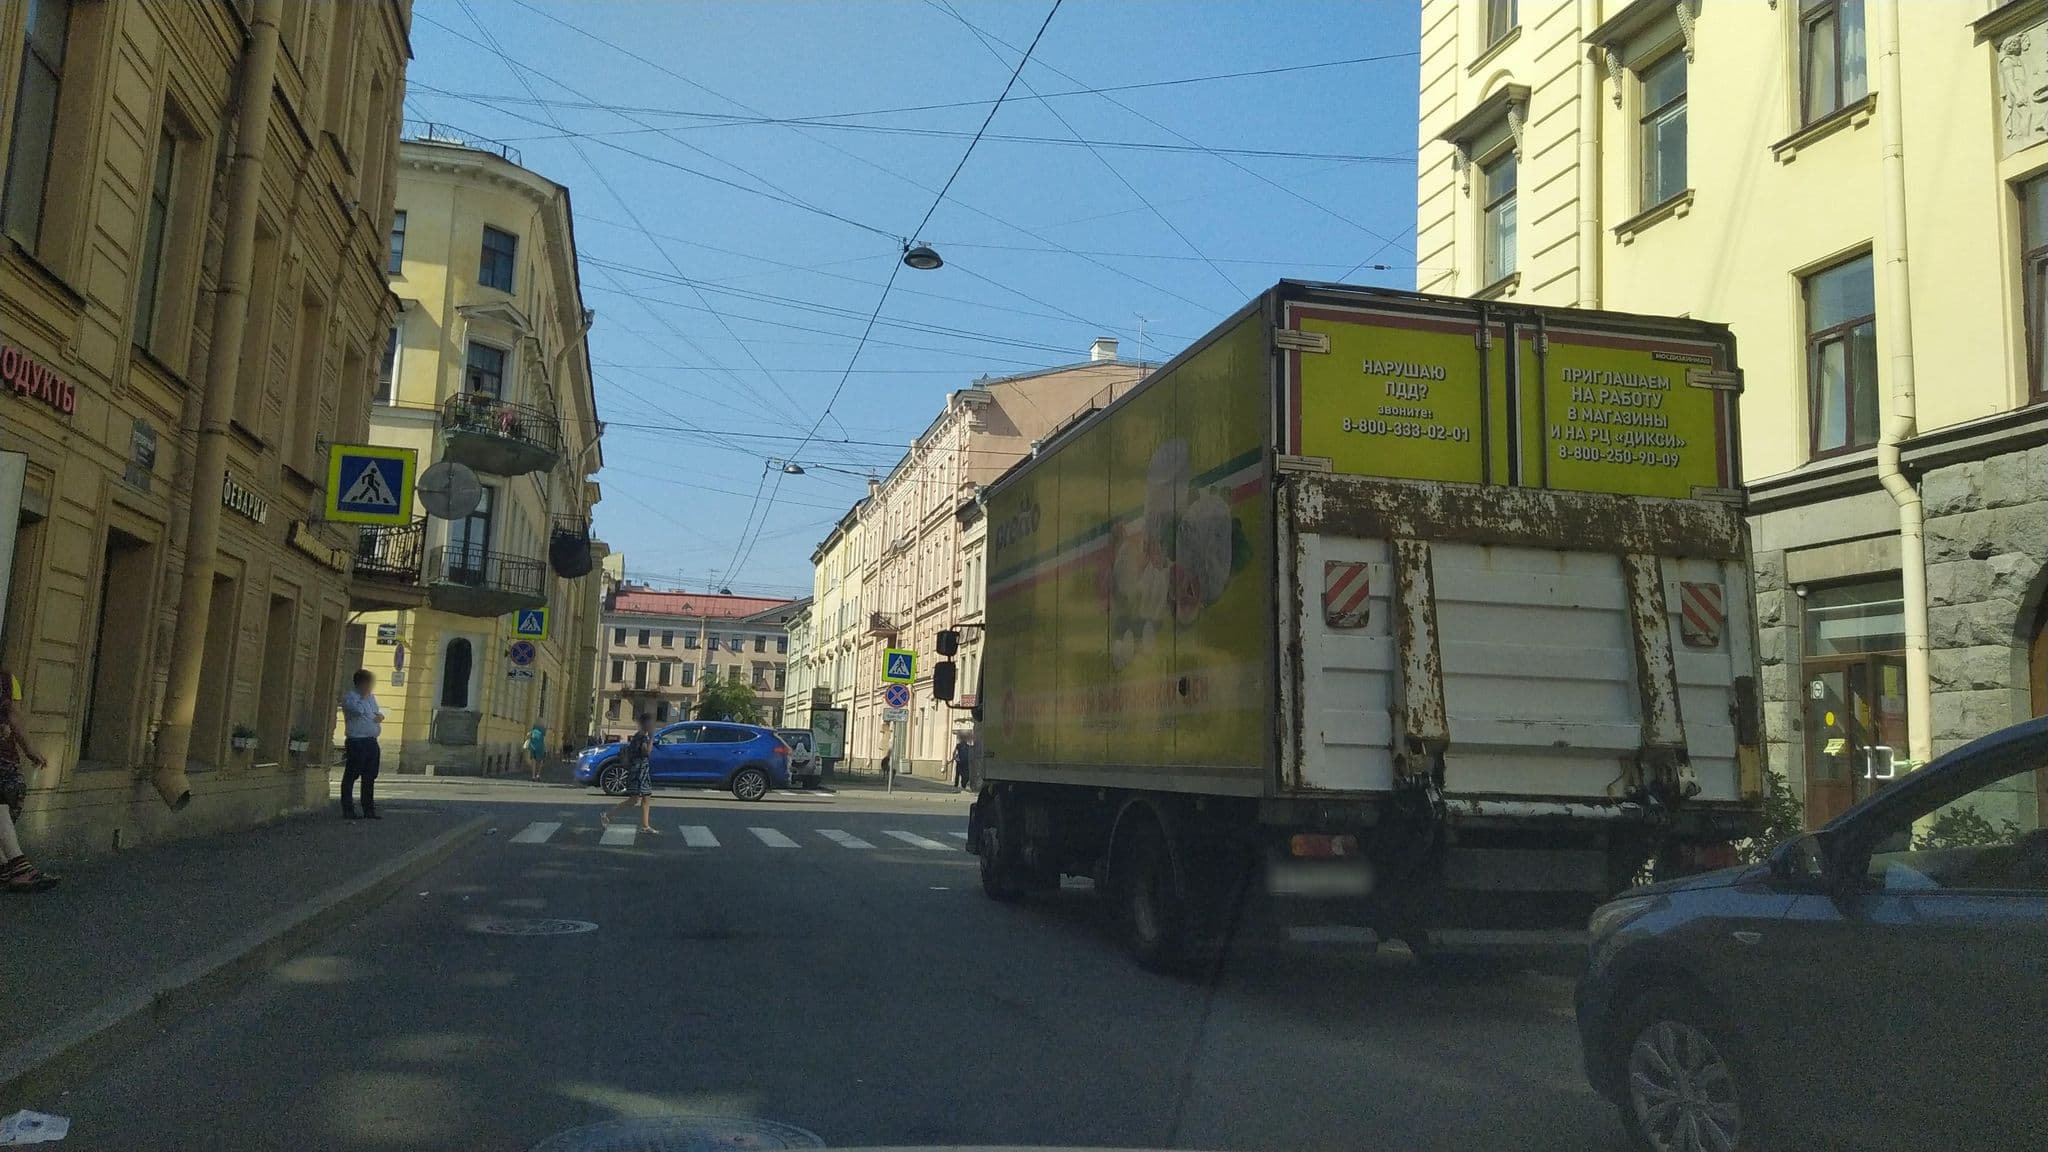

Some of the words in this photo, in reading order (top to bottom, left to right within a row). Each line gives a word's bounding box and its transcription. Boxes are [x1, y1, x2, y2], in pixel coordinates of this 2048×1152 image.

[0, 345, 76, 414] ОДУКТЫ
[1362, 359, 1446, 381] НАРУШАЮ
[1562, 367, 1671, 391] ПРИГЛАШАЕМ
[1385, 381, 1428, 401] ПДД?
[1571, 386, 1595, 403] НА
[1599, 388, 1663, 409] РАБОТУ
[1377, 405, 1434, 419] звоните:
[1567, 406, 1578, 422] В
[1581, 407, 1669, 429] МАГАЗИНЫ
[1342, 417, 1470, 442] 8-800-333-02-01
[1551, 424, 1561, 440] И
[1565, 425, 1586, 442] НА
[1590, 427, 1611, 446] РЦ
[1615, 430, 1687, 449] «ДИКСИ»
[1559, 444, 1680, 468] 8-800-250-90-09
[223, 478, 270, 526] ФЕВАРИМ
